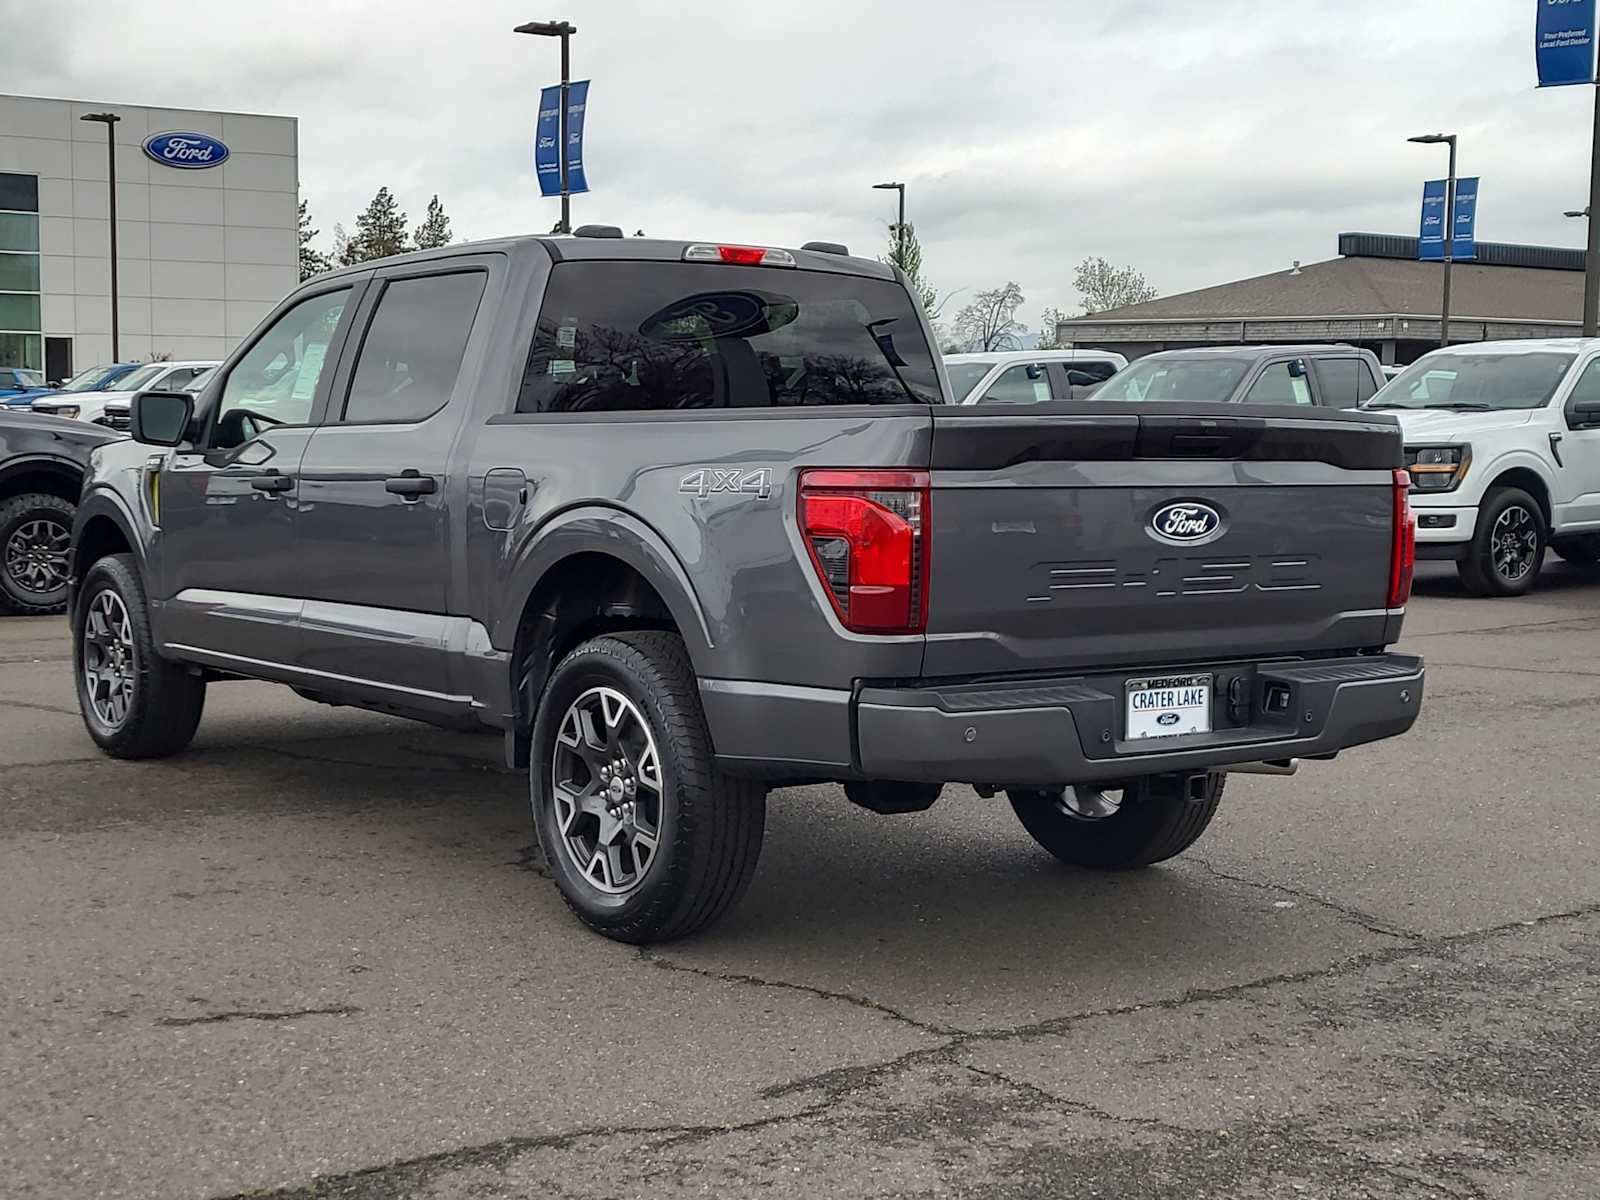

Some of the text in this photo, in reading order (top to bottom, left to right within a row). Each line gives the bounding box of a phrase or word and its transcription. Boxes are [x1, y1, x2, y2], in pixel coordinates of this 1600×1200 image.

[164, 138, 213, 160] Ford
[1165, 508, 1209, 533] Ford
[1027, 553, 1323, 601] F-150
[1147, 677, 1194, 690] MEDFORD
[1132, 688, 1204, 710] CRATER LAKE
[1160, 714, 1177, 725] Ford
